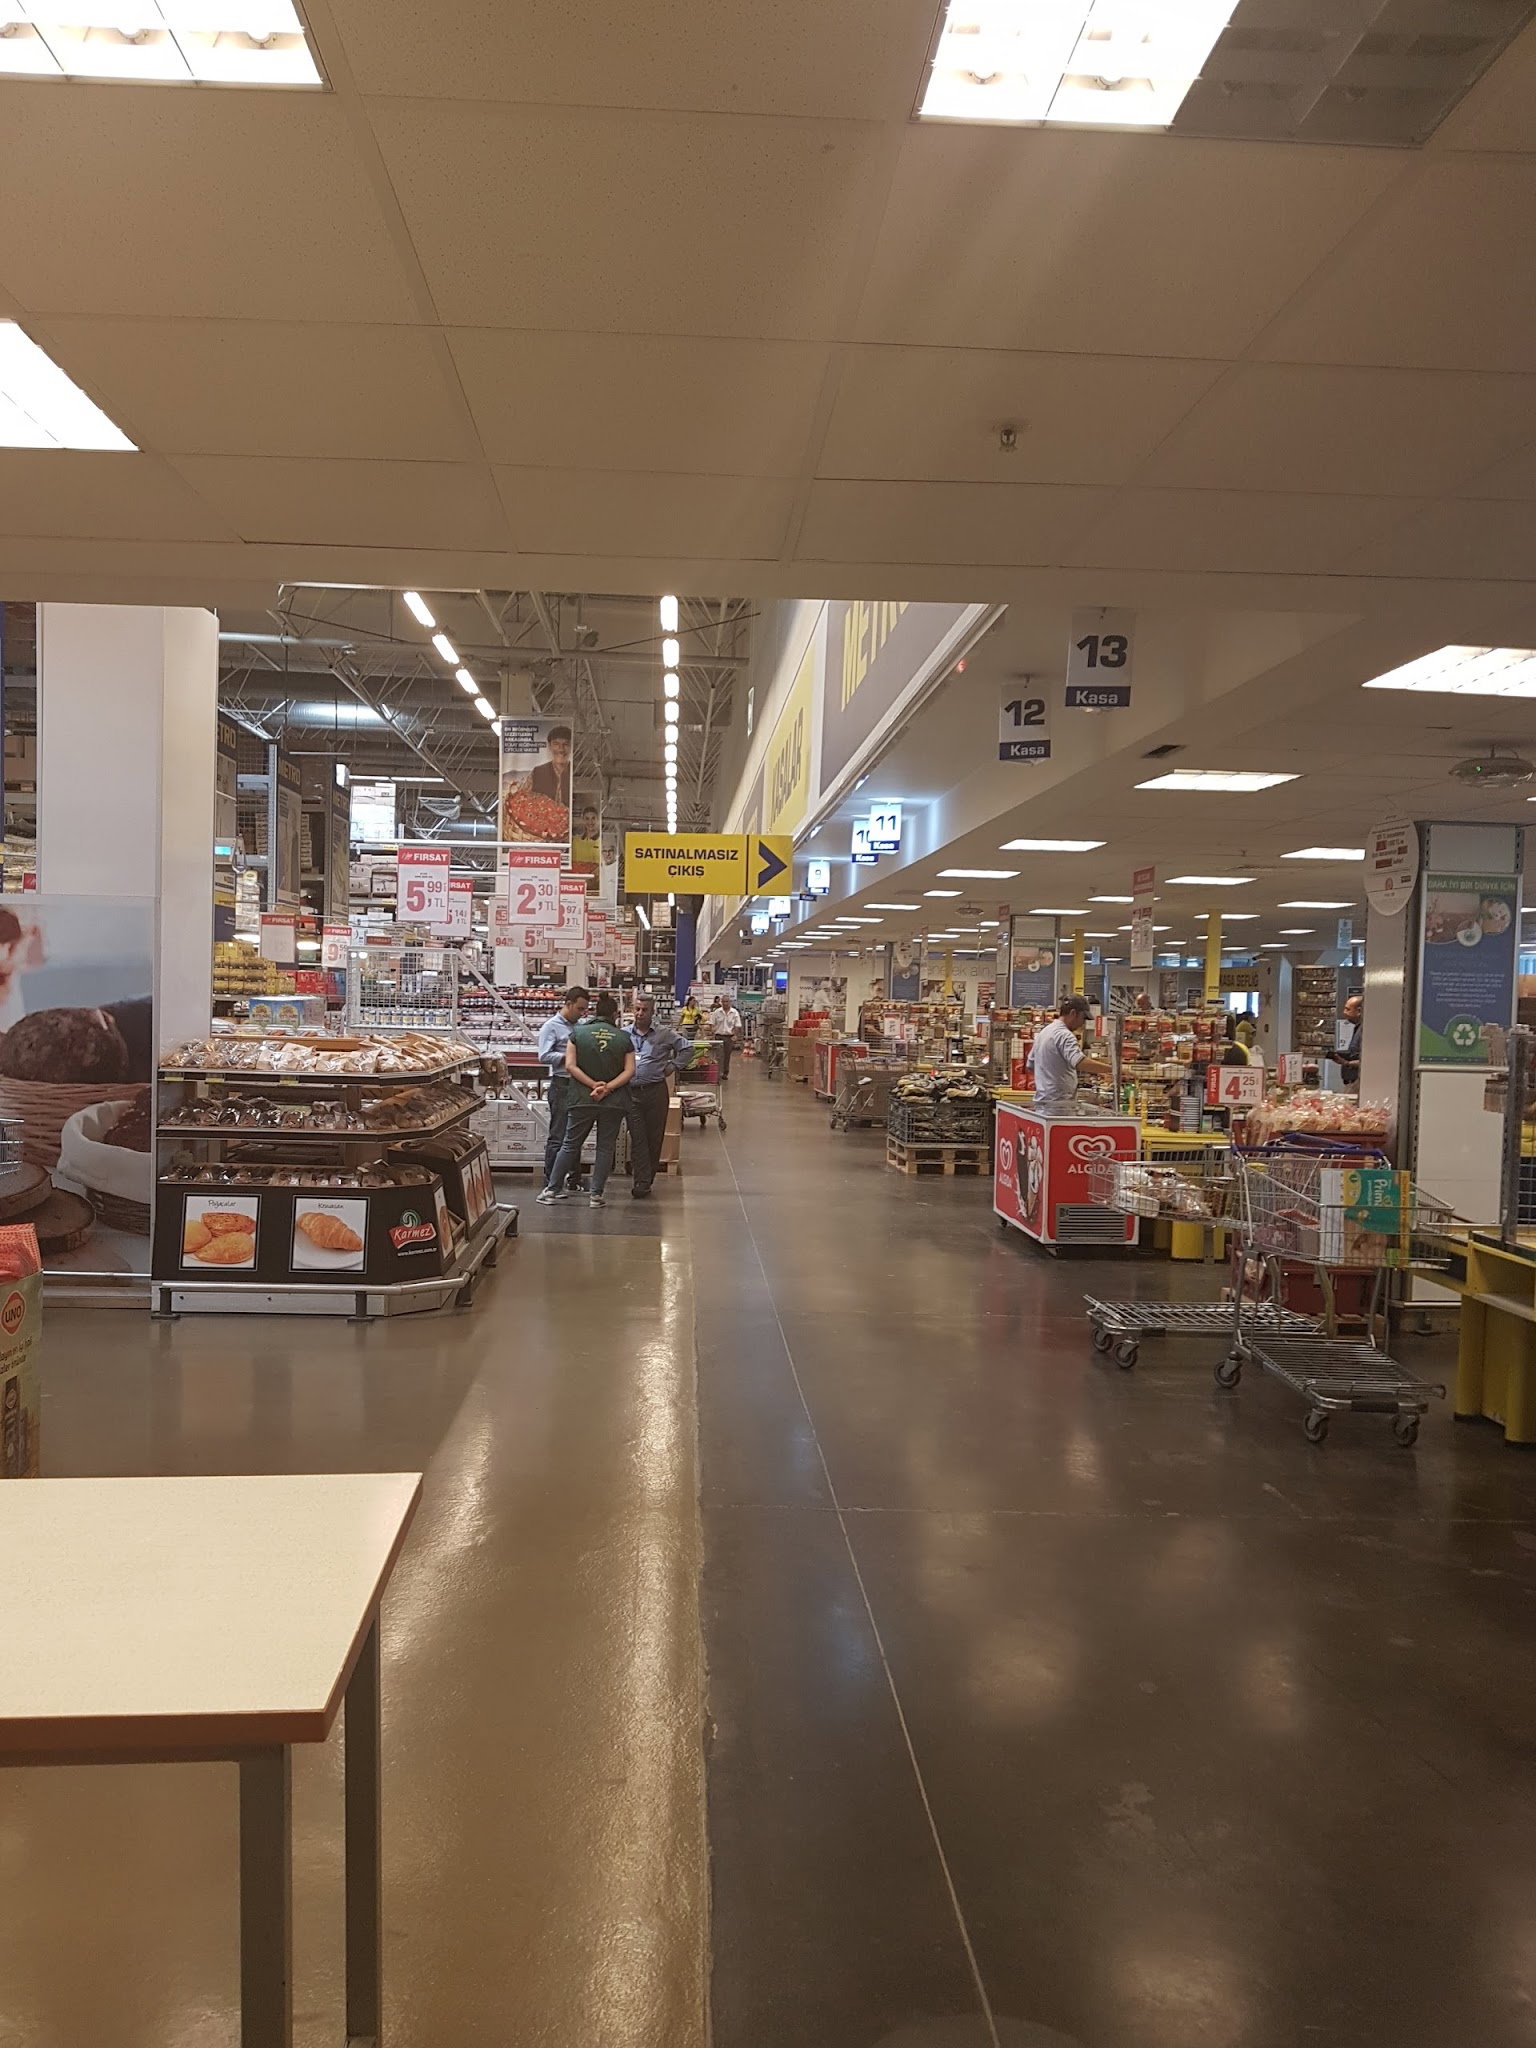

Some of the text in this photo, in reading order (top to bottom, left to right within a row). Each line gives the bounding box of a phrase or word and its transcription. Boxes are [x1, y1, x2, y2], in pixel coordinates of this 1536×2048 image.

[1077, 635, 1128, 668] 13
[1076, 690, 1118, 704] Kasa
[1004, 699, 1045, 726] 12
[1010, 744, 1045, 756] Kasa
[876, 815, 896, 831] 11
[873, 842, 895, 850] Kasa
[413, 853, 448, 861] FIRSAT
[525, 856, 558, 864] FIRSAT
[635, 848, 739, 860] SATINALMASIZ
[427, 881, 442, 893] 99
[538, 884, 553, 896] 30
[1243, 1076, 1255, 1086] 25
[1067, 1163, 1113, 1174] ALGIDA
[394, 1228, 431, 1240] Karmez
[5, 1306, 21, 1323] UNO
